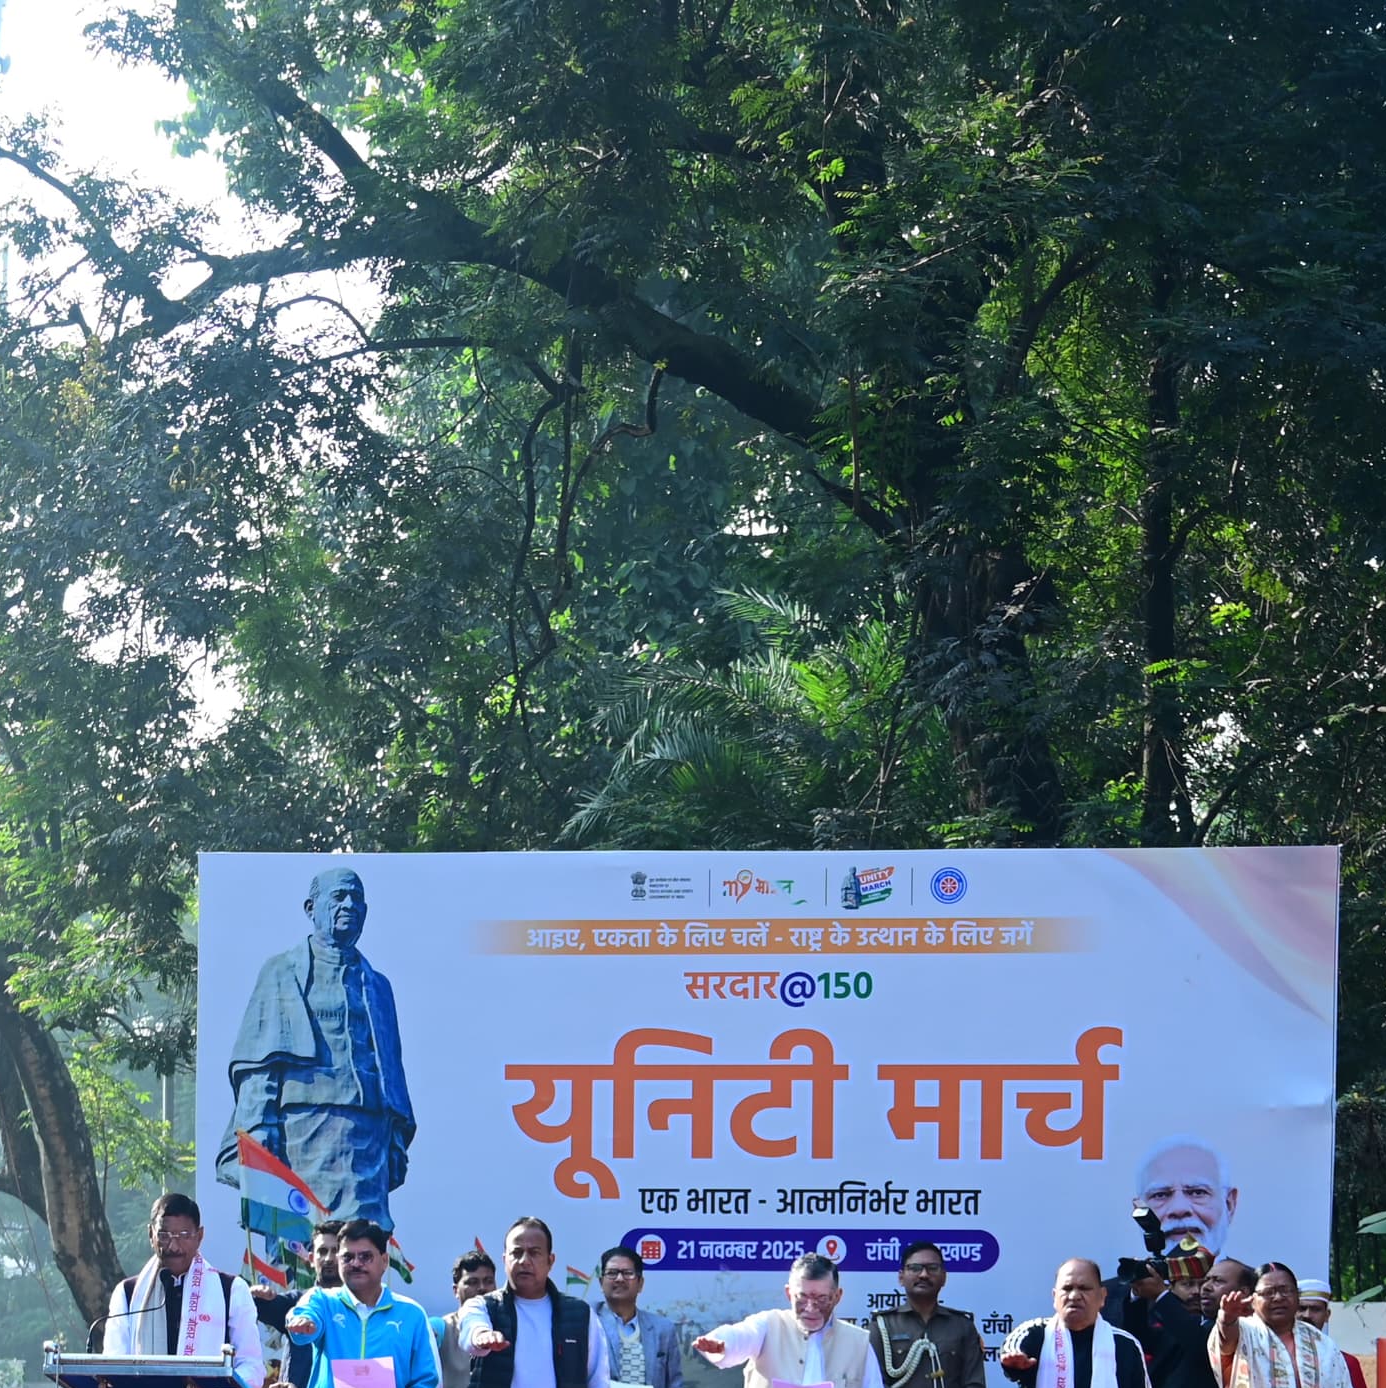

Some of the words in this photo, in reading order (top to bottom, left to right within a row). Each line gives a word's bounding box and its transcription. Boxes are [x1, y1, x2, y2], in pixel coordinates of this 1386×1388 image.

[859, 869, 890, 884] UNITY
[861, 880, 892, 892] MARCH
[526, 928, 586, 950] आइए,
[592, 928, 651, 948] एकता
[656, 922, 678, 948] के
[684, 922, 725, 948] लिए
[731, 922, 770, 947] चलें
[789, 927, 824, 951] राष्ट्र
[829, 921, 851, 947] के
[856, 926, 918, 947] उत्थान
[924, 920, 945, 946] के
[951, 920, 994, 946] लिए
[999, 920, 1034, 946] जगें
[684, 971, 873, 1007] सरदार@150
[504, 1028, 849, 1200] यूनिटी
[877, 1026, 1123, 1160] मार्च
[639, 1188, 679, 1215] एक
[687, 1188, 751, 1215] भारत
[776, 1181, 910, 1216] आत्मनिर्भर
[915, 1188, 981, 1216] भारत
[677, 1242, 694, 1260] 21
[699, 1240, 758, 1260] नवम्बर
[762, 1240, 804, 1260] 2025
[865, 1237, 901, 1261] रांची
[981, 1310, 1013, 1334] राँची
